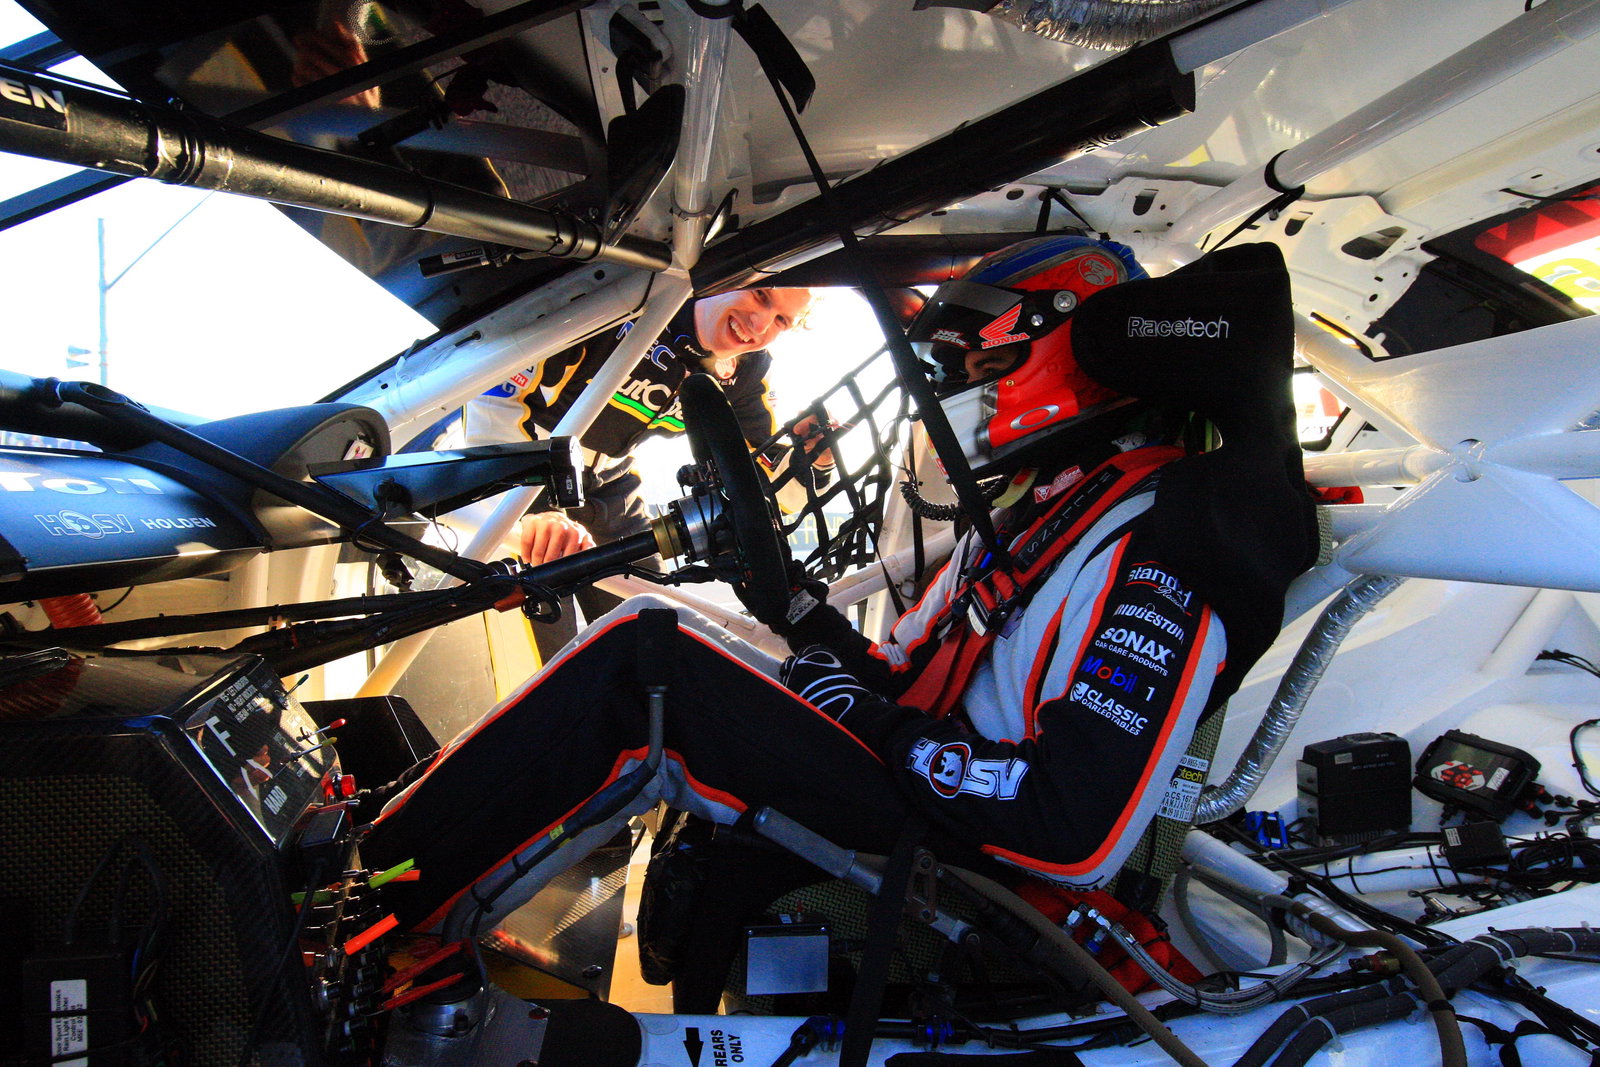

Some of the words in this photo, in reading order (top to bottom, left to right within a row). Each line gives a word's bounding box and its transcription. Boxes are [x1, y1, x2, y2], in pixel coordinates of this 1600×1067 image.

[981, 332, 1030, 349] HONDA
[1127, 315, 1230, 339] Racetech
[140, 517, 217, 530] HOLDEN
[1027, 471, 1112, 553] WILLANS
[1095, 640, 1108, 649] CAR
[1108, 644, 1127, 657] CARE
[1128, 652, 1169, 677] PRODUCTS
[1101, 627, 1172, 665] SONAX
[1081, 655, 1139, 693] Mobil
[1145, 686, 1156, 702] 1
[1087, 689, 1149, 730] CLASSIC
[205, 716, 236, 757] F
[905, 737, 1031, 800] HSV
[264, 785, 288, 815] HARD
[710, 1029, 728, 1067] REARS
[727, 1033, 745, 1063] ONLY
